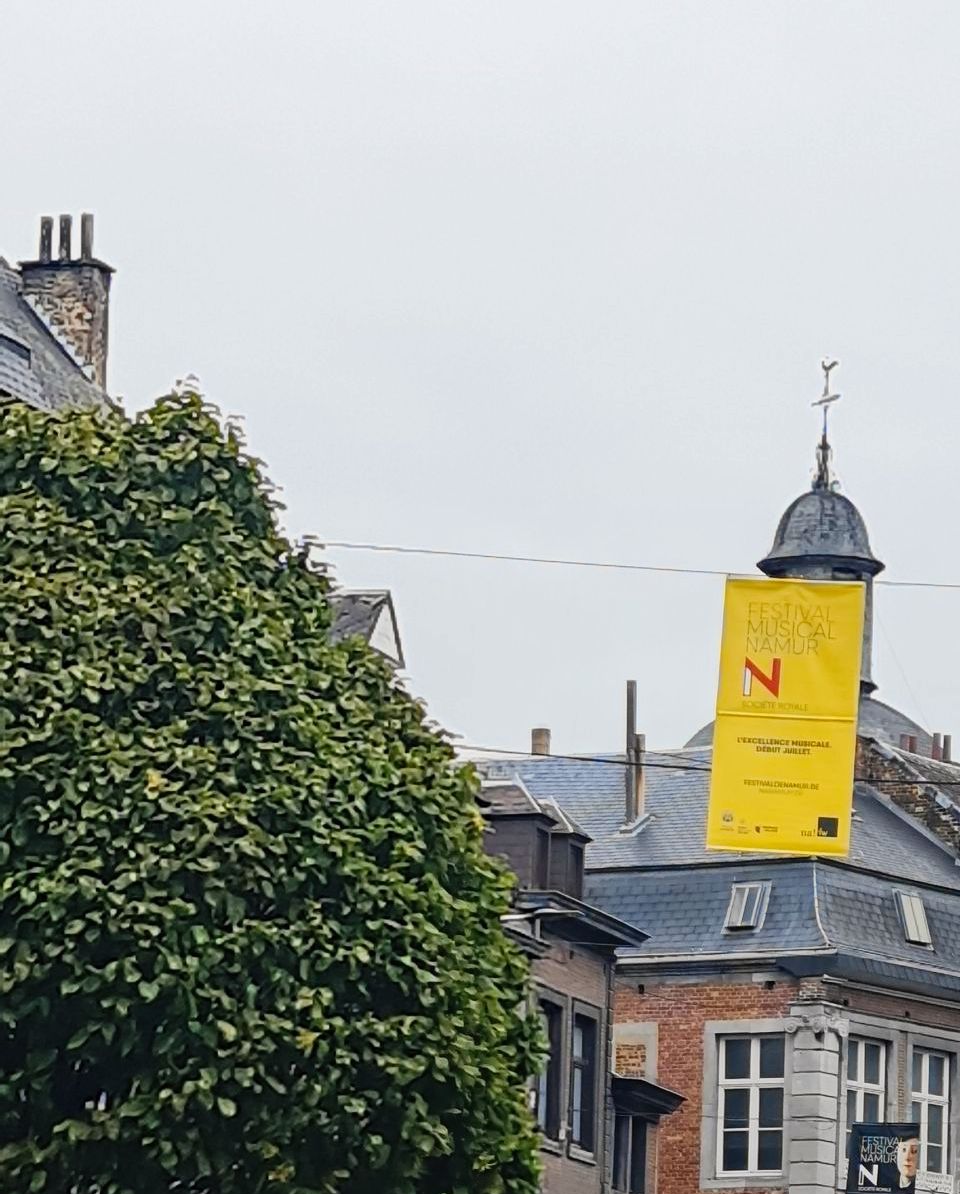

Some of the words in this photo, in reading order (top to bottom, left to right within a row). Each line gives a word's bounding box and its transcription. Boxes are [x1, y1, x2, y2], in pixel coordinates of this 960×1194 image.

[747, 601, 834, 623] FESTIVAL
[746, 619, 837, 640] MUSICAL
[745, 637, 819, 655] NAMUR
[743, 656, 781, 698] N
[860, 1153, 898, 1164] NAMUR
[858, 1164, 879, 1186] N
